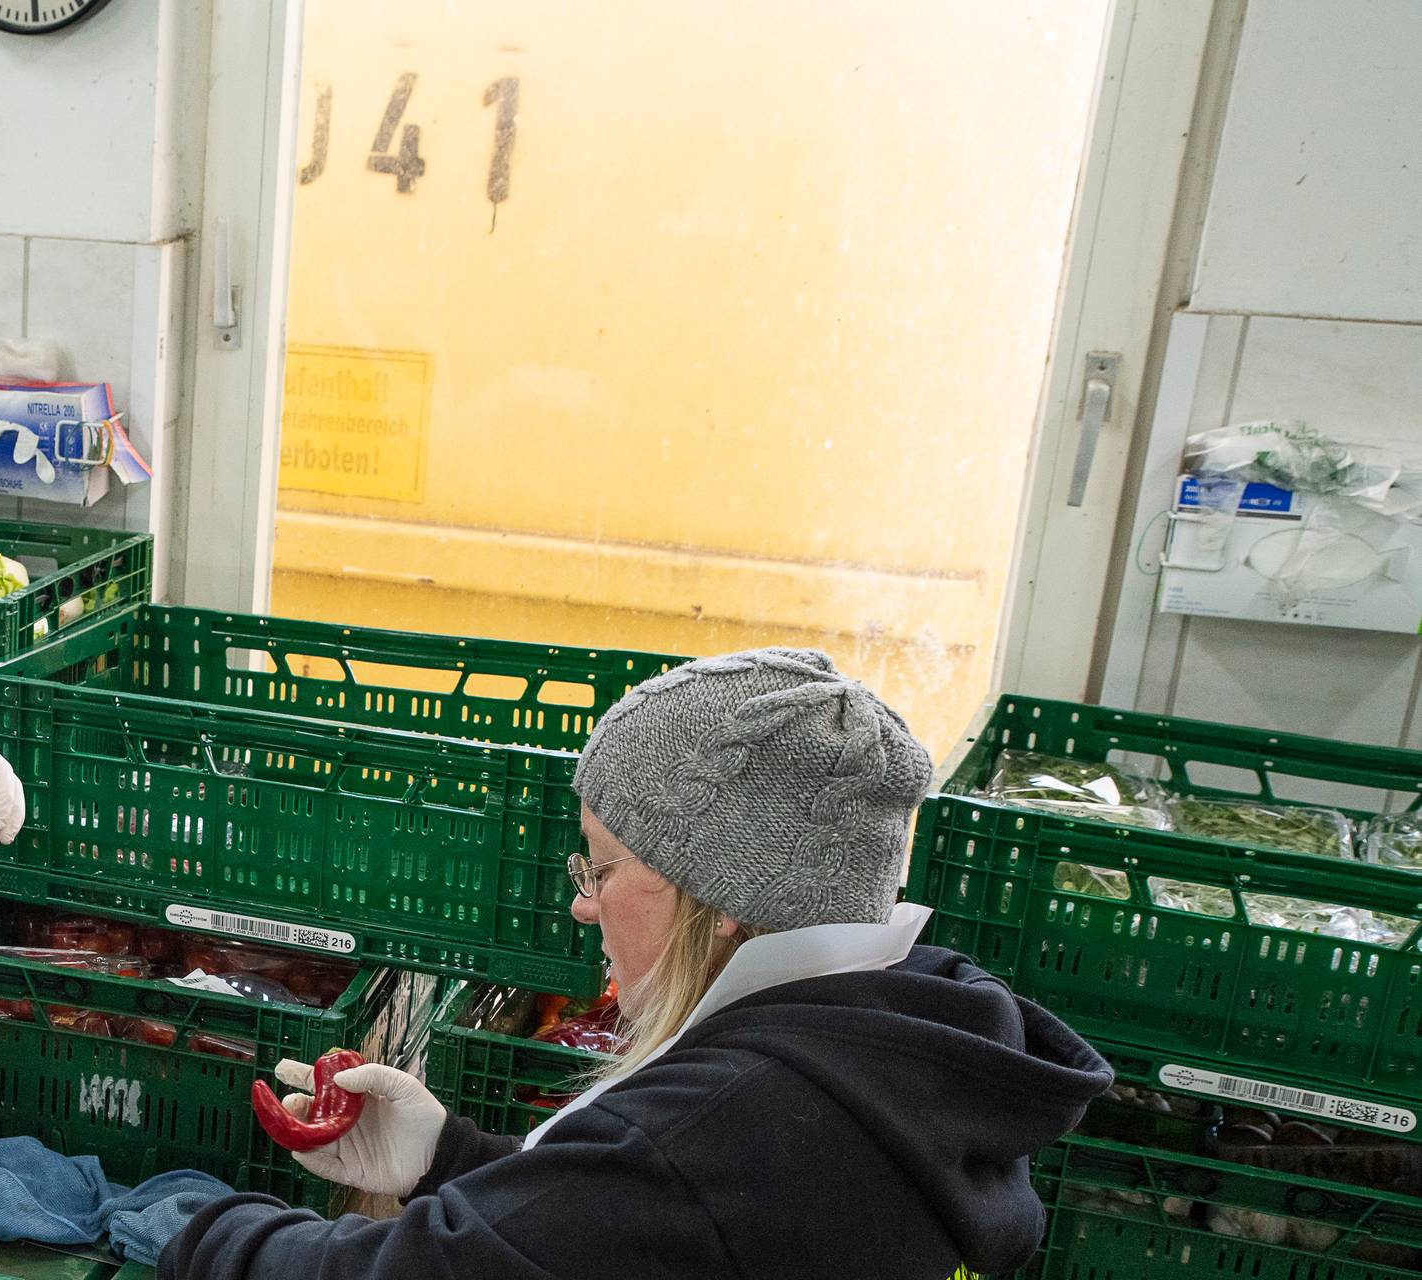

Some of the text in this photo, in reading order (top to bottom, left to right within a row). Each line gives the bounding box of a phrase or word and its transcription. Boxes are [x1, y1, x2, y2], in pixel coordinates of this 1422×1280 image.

[284, 366, 389, 402] ufenthalt
[27, 402, 75, 417] NITRELLA 200
[282, 408, 408, 437] efahrenbereich
[280, 440, 380, 475] erboten!
[331, 937, 352, 950] 216
[1381, 1112, 1410, 1128] 216
